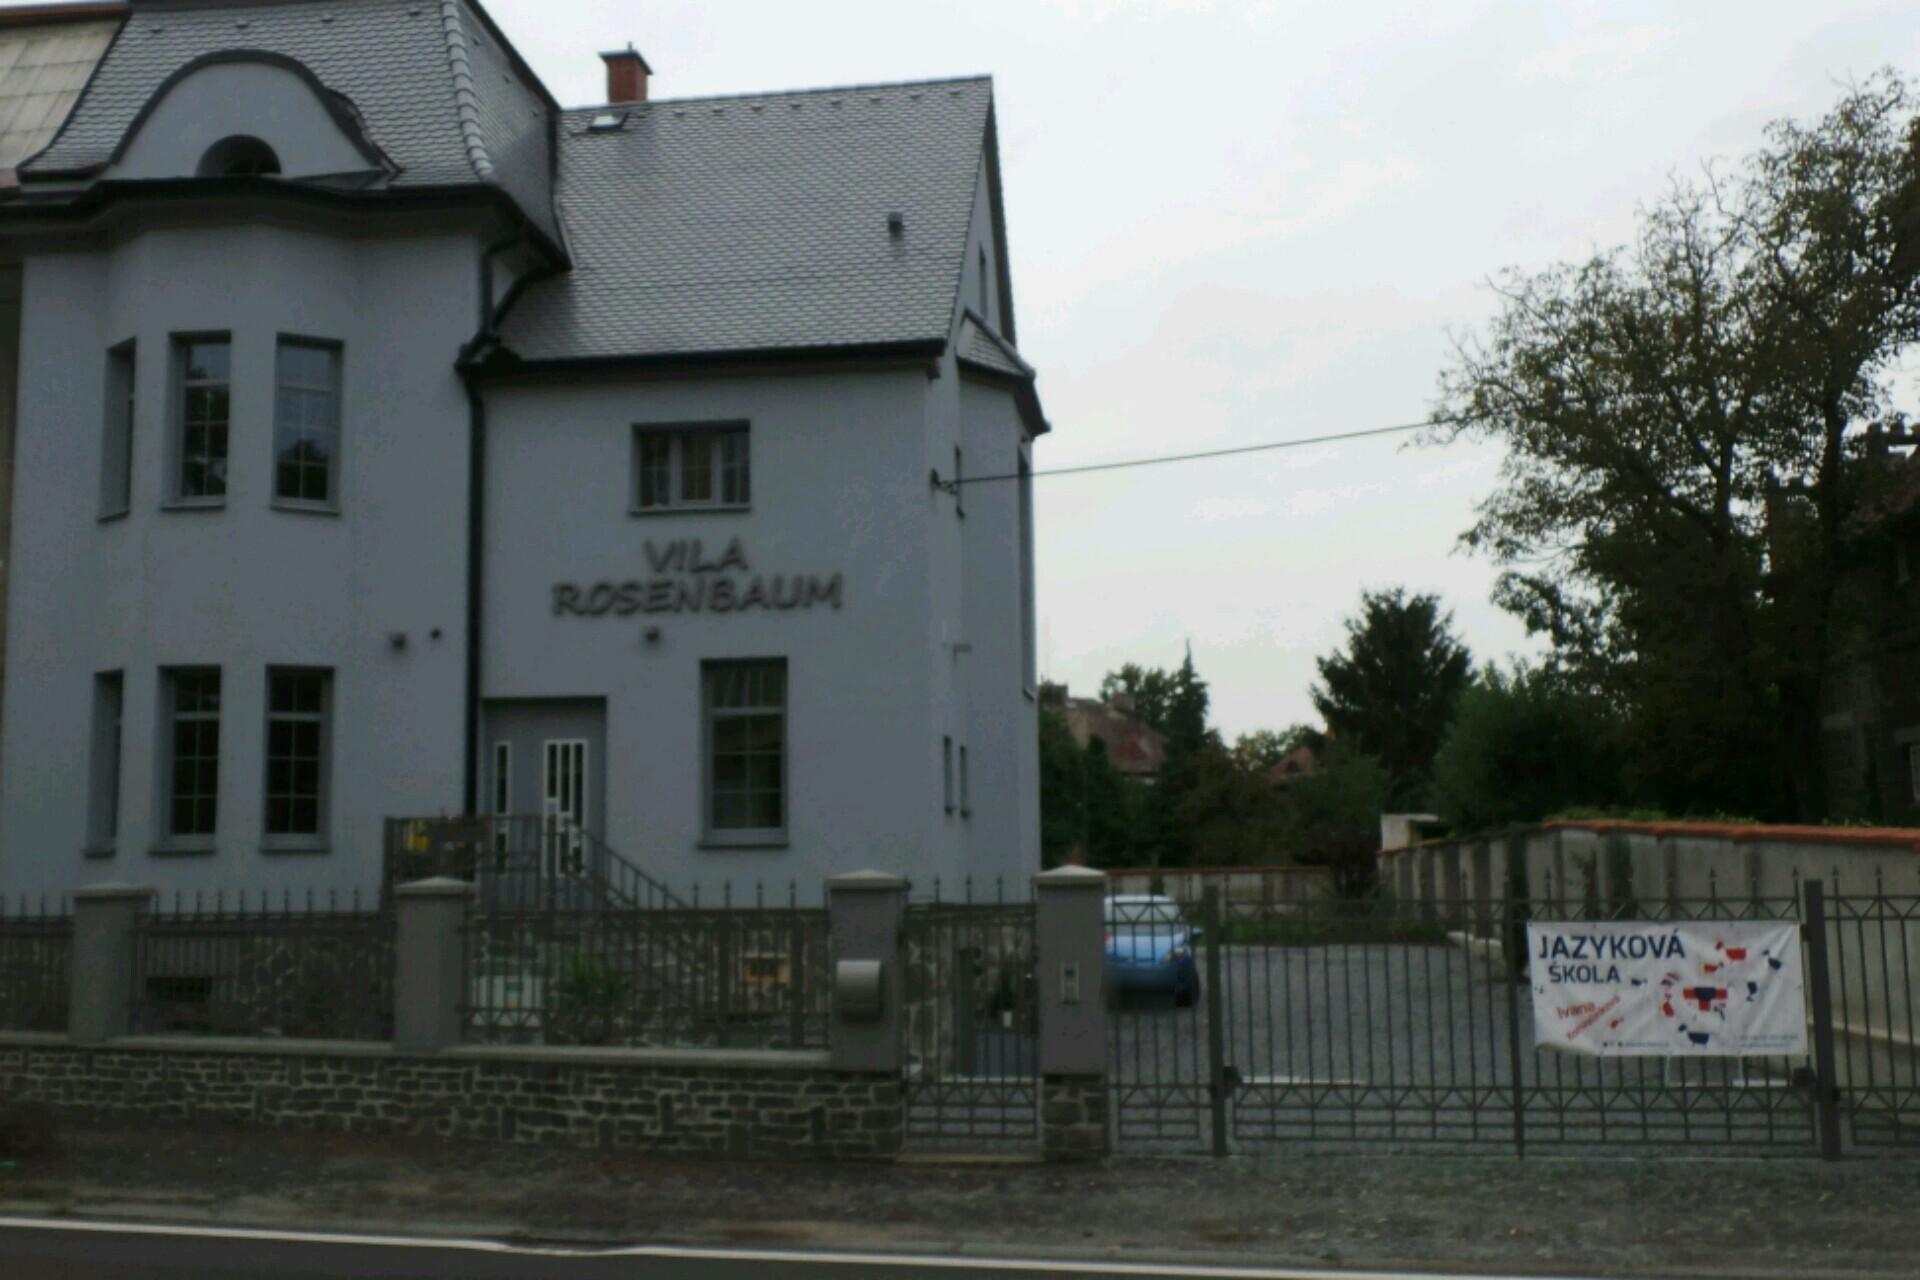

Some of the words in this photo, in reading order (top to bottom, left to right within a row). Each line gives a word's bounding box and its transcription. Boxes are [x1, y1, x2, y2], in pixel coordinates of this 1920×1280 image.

[643, 538, 749, 573] VILA
[551, 573, 843, 617] ROSENBAUM
[1539, 928, 1685, 959] JAZYKOVÁ
[1548, 961, 1621, 984] ŠKOLA
